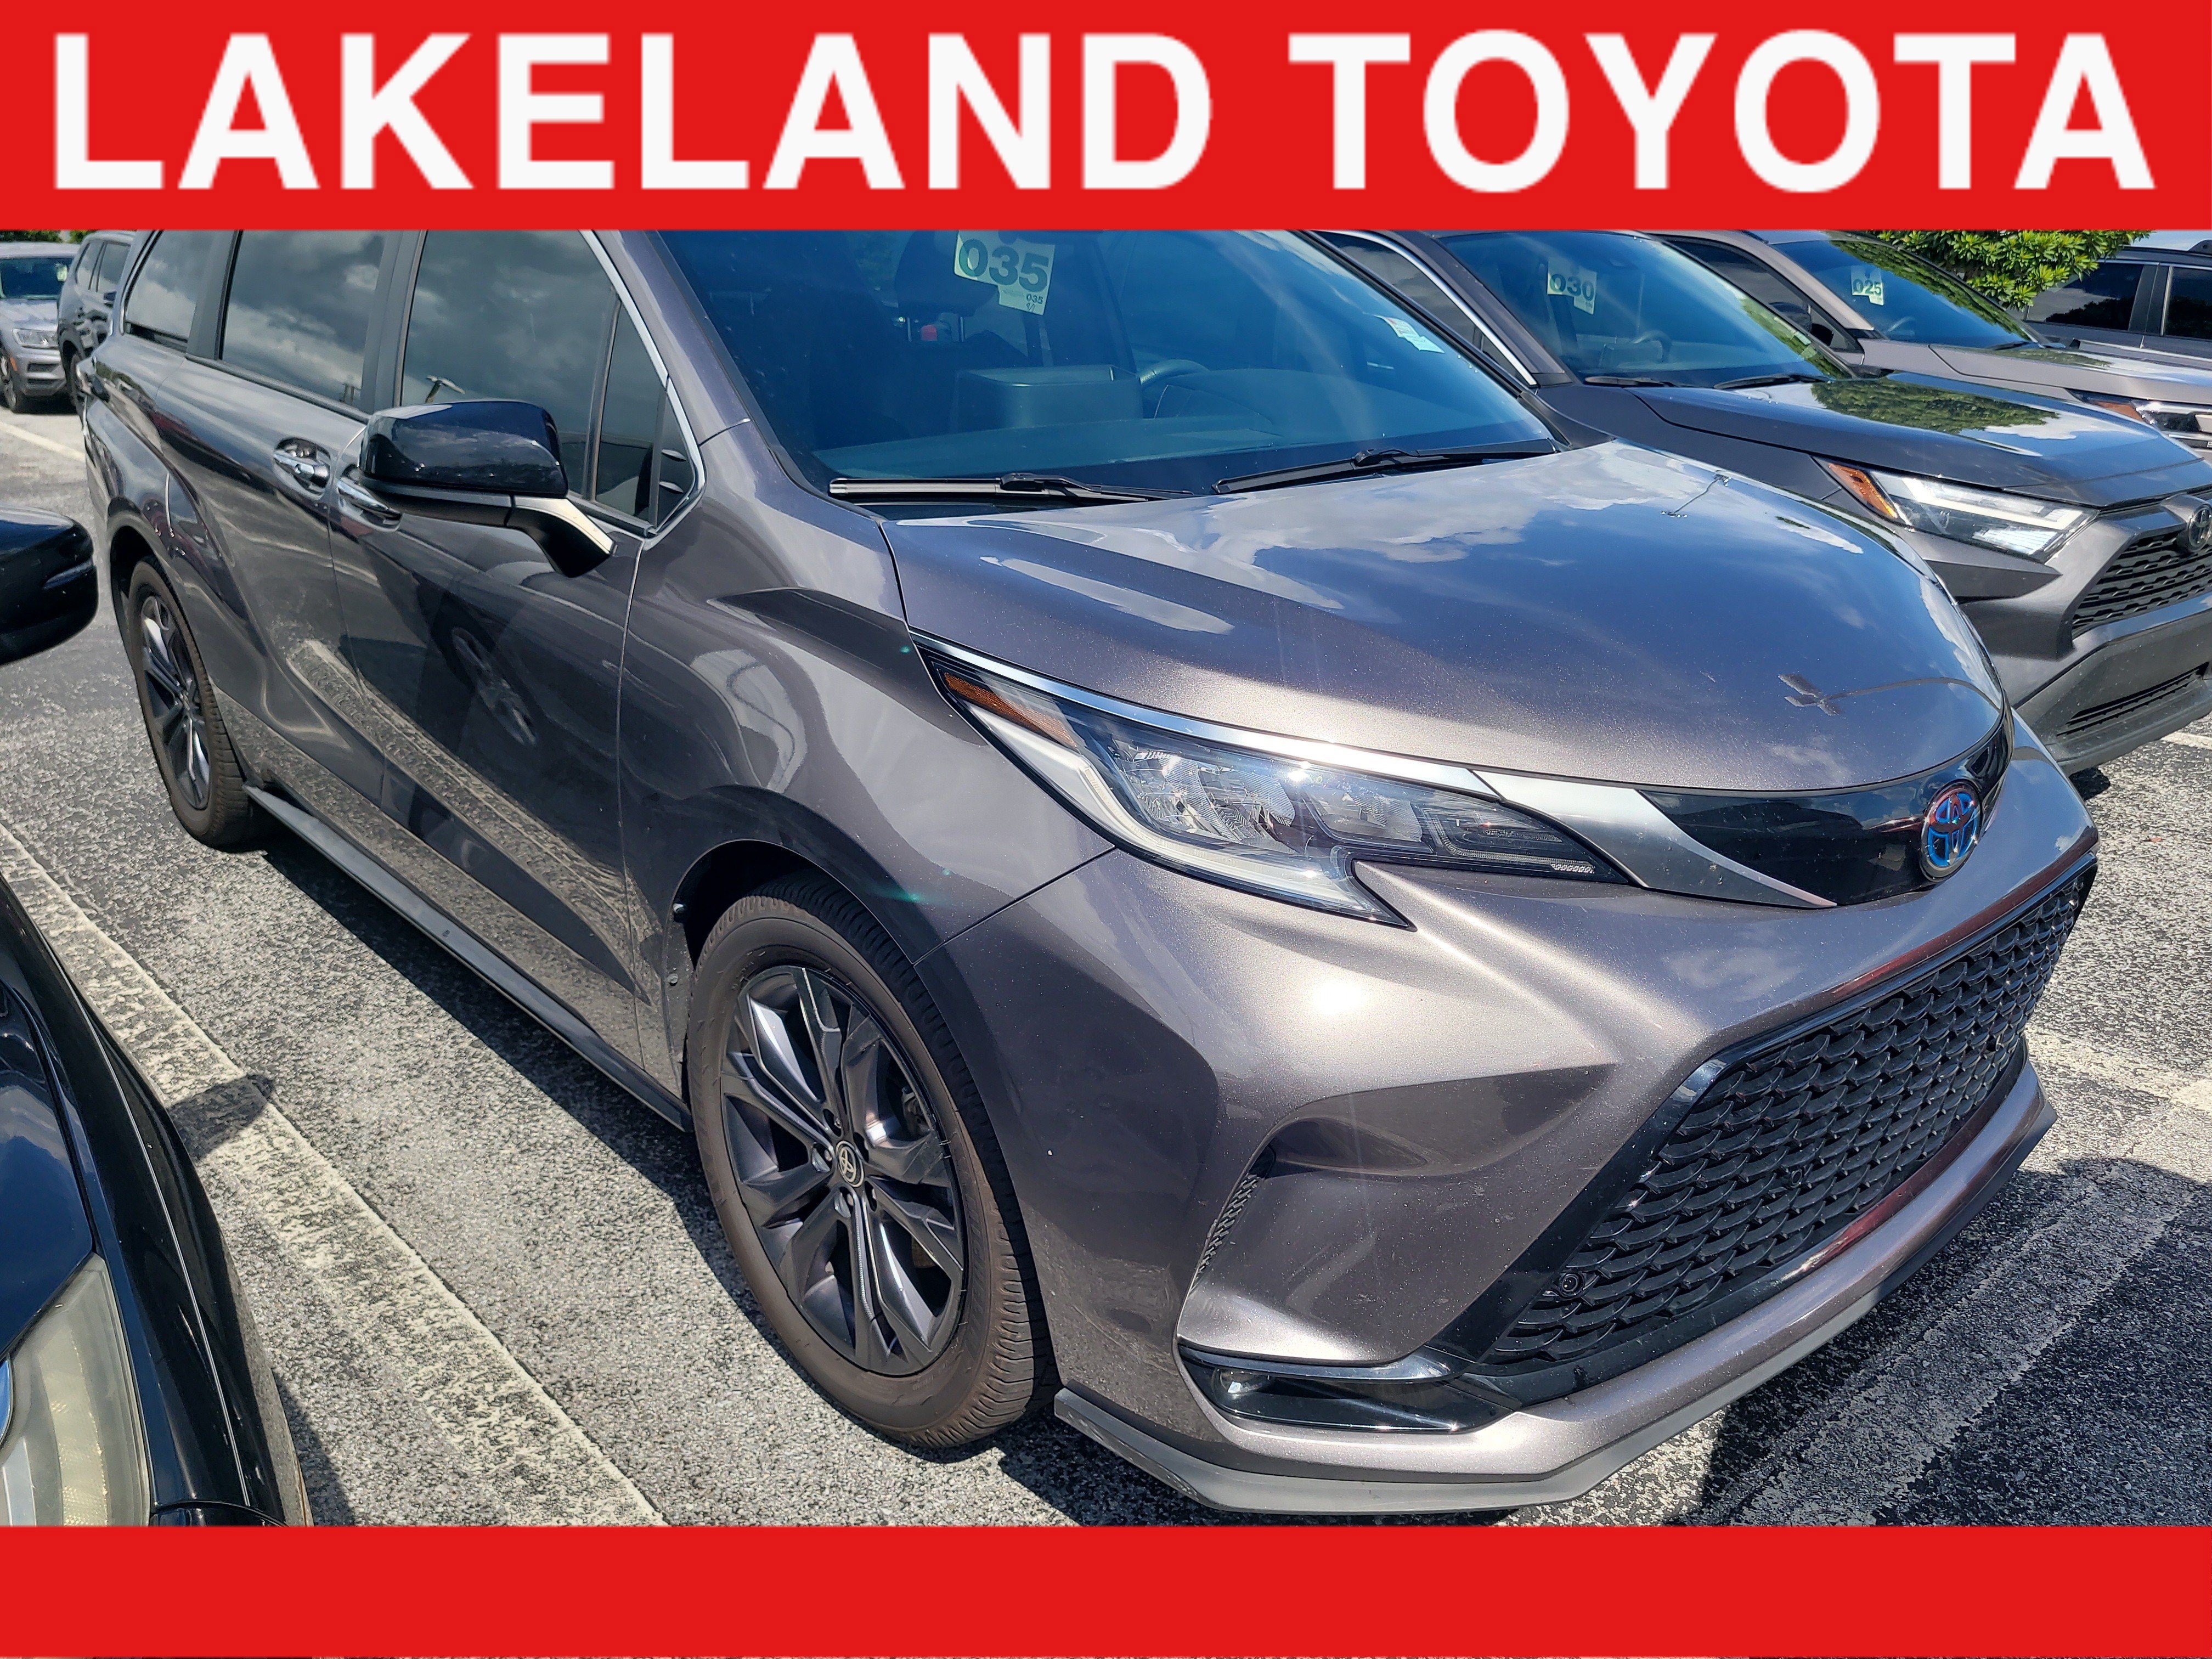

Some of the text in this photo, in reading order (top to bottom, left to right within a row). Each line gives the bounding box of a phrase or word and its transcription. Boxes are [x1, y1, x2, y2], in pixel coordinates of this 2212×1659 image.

[959, 239, 1049, 292] 035
[1550, 274, 1594, 301] 030
[1853, 279, 1882, 296] 025
[1026, 294, 1043, 304] 035
